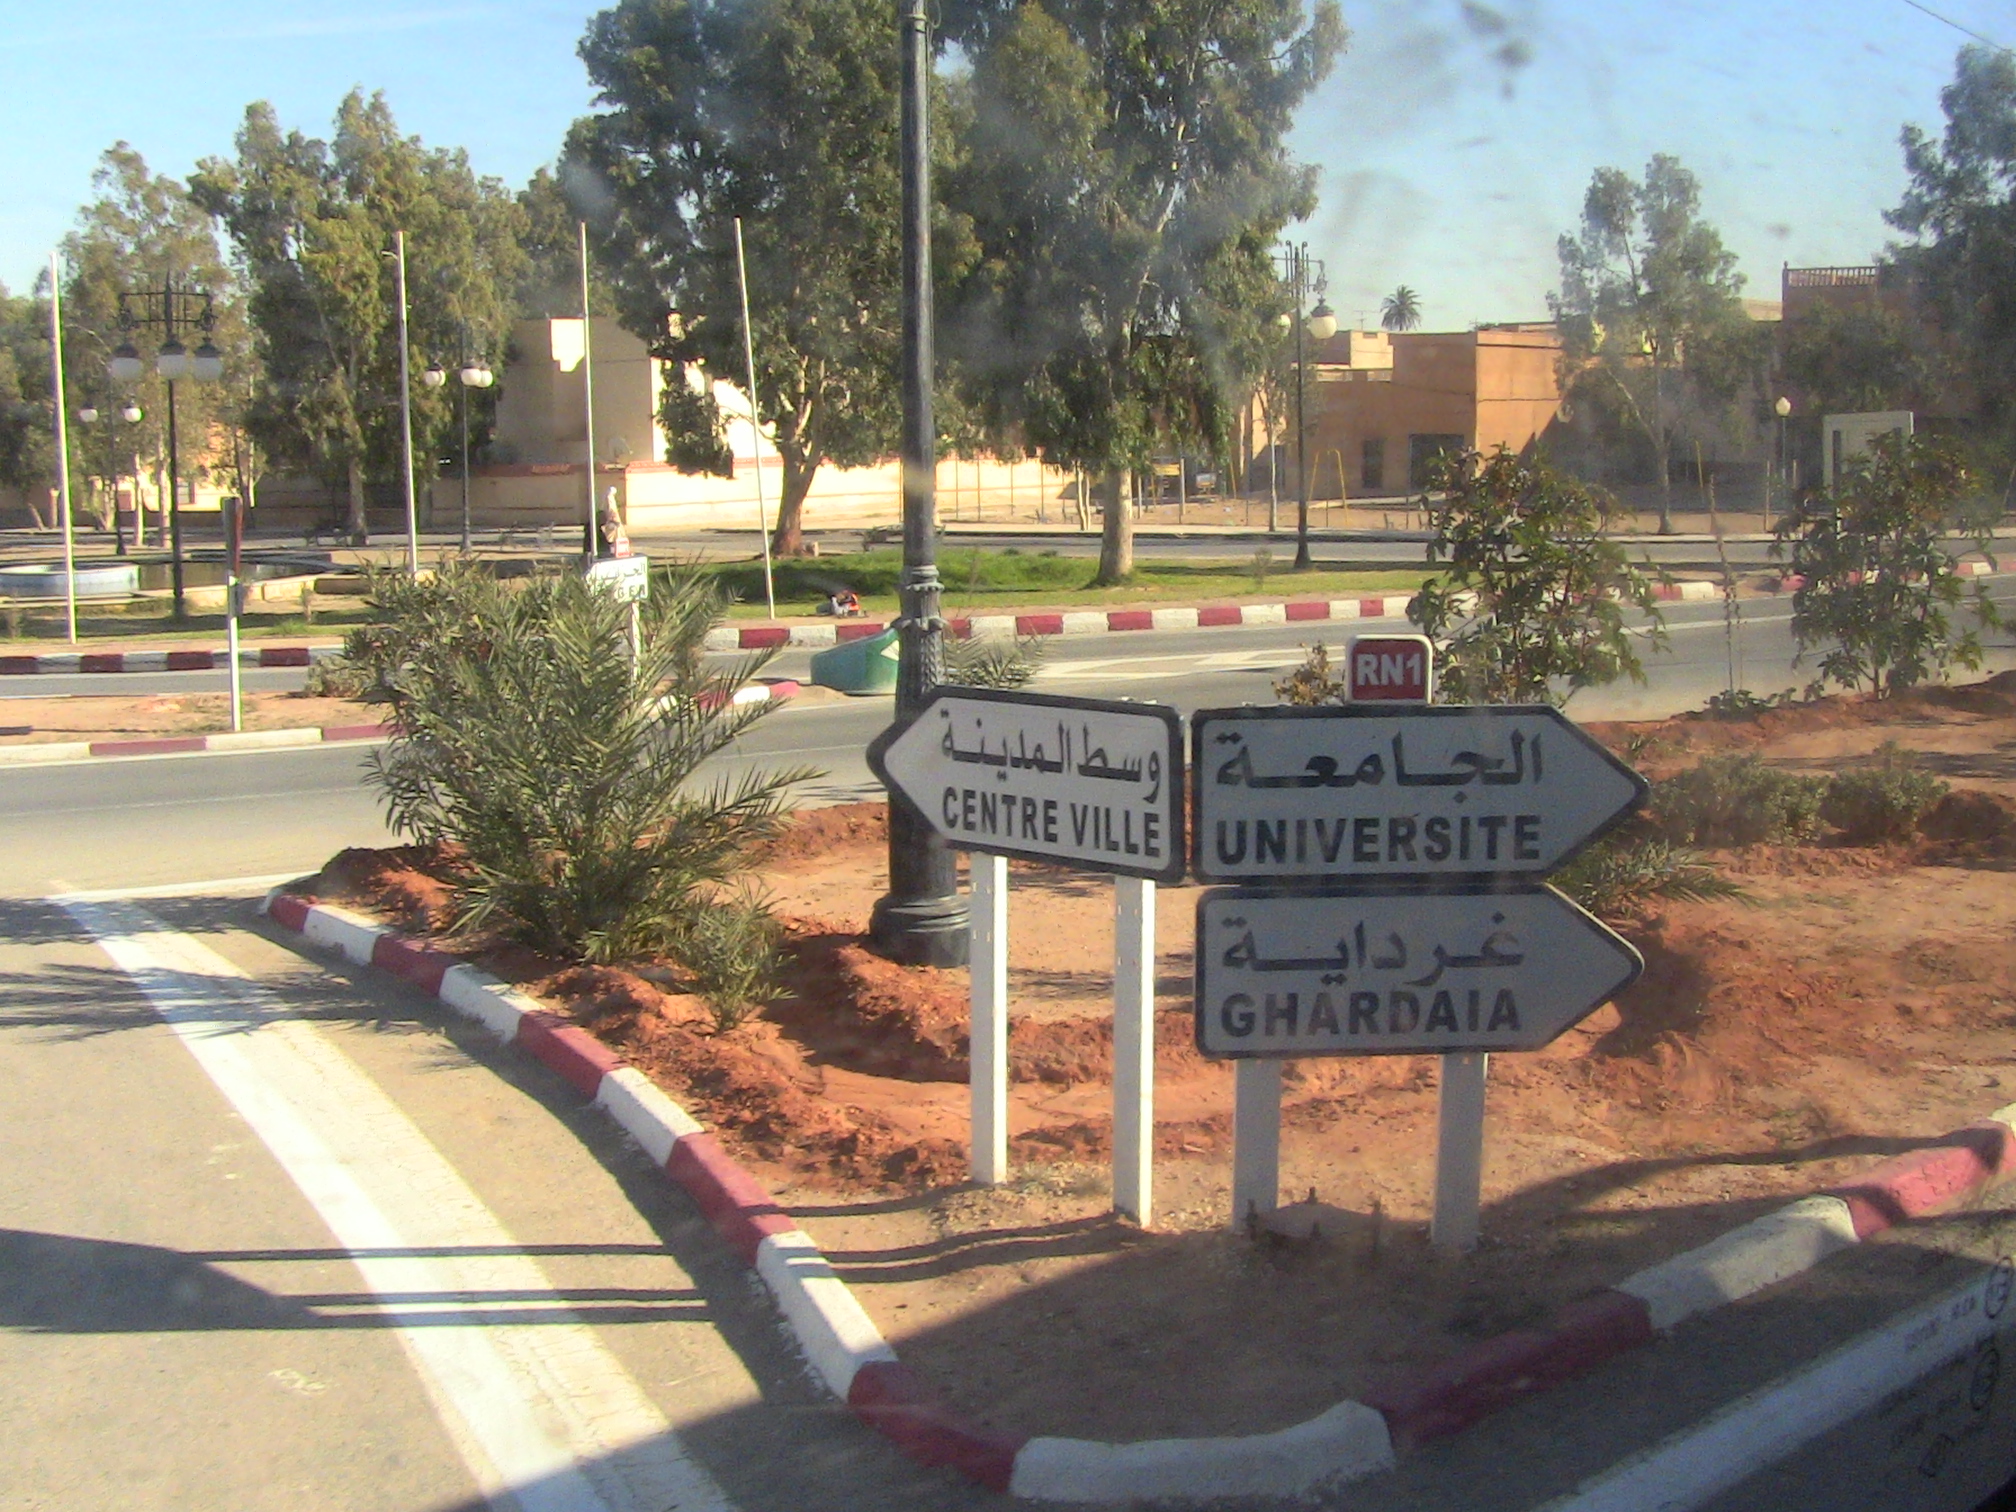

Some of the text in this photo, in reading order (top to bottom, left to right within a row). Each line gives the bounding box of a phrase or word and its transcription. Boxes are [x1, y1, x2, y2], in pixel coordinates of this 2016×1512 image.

[1357, 653, 1421, 686] RN1
[940, 708, 1161, 803] وسط المدينة
[1214, 728, 1544, 804] الجامعة
[942, 786, 1161, 857] CENTRE VILLE
[1216, 814, 1542, 865] UNIVERSITE
[1221, 910, 1524, 987] غرداية
[1220, 988, 1522, 1038] GHARDAIA
